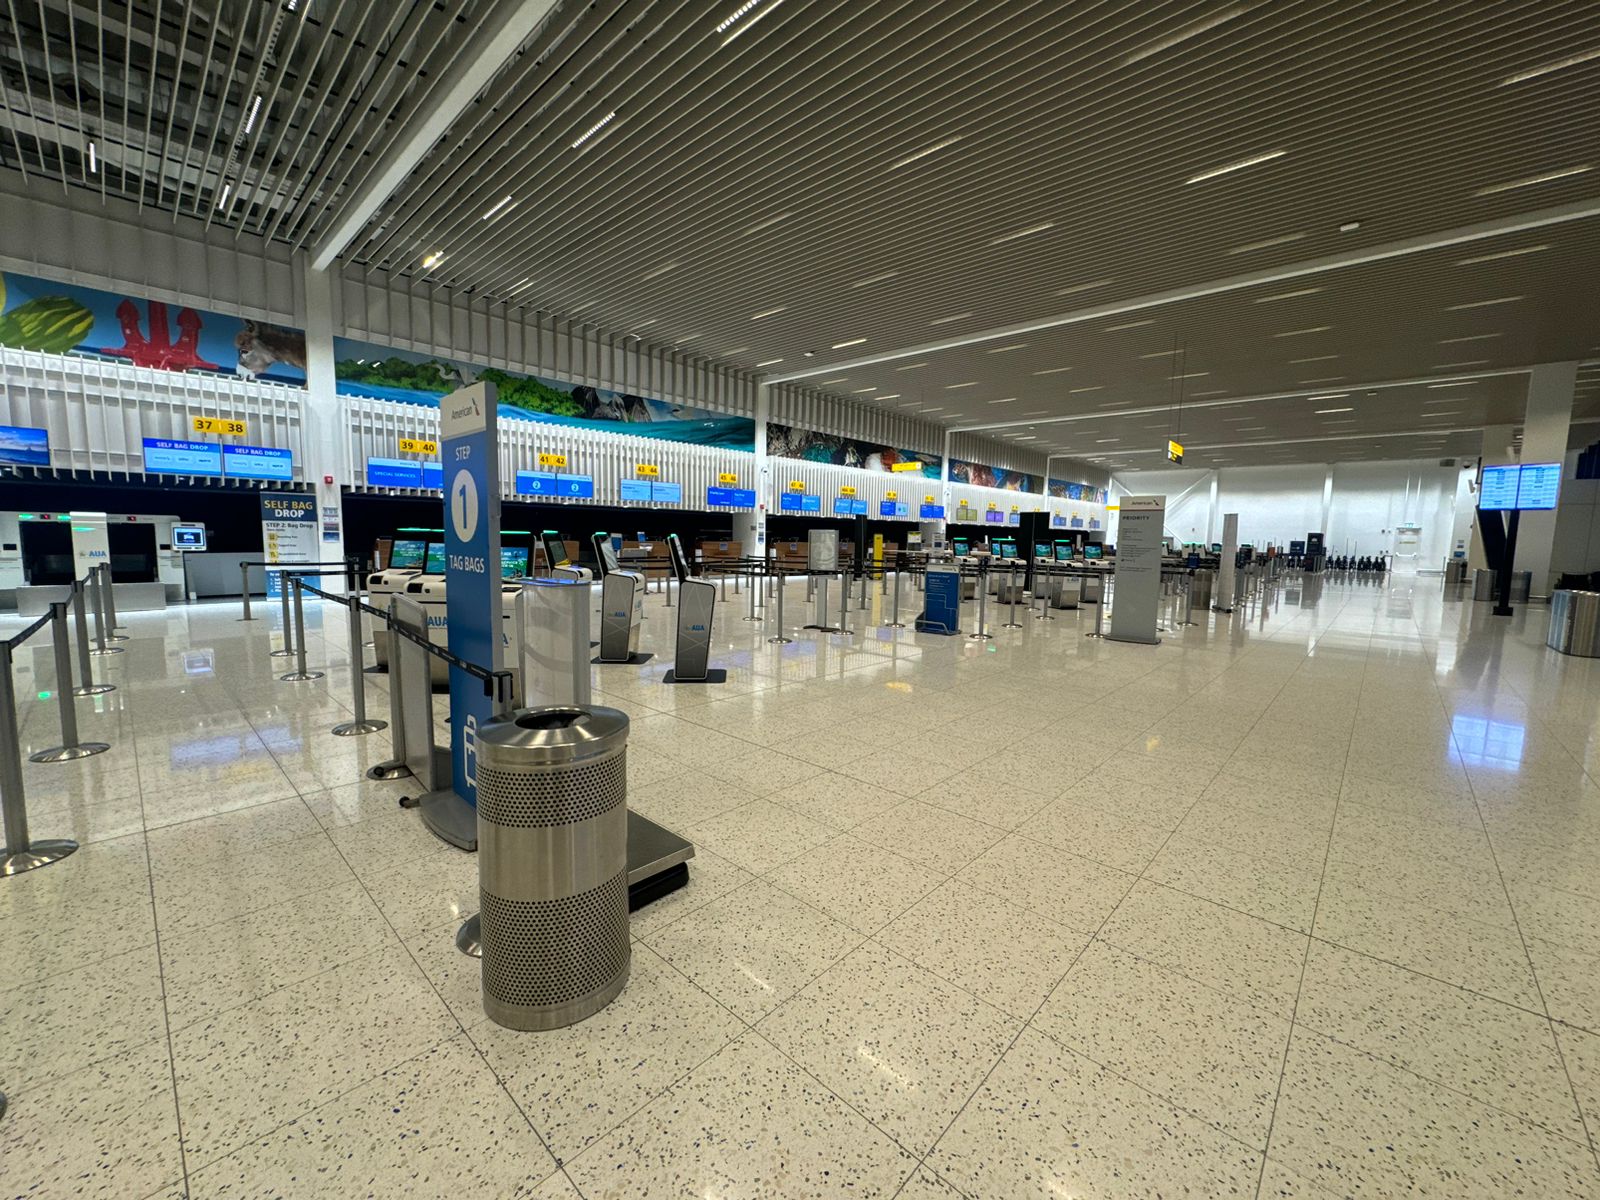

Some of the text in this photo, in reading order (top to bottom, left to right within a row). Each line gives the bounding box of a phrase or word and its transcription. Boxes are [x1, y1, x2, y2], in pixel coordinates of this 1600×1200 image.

[451, 405, 473, 420] American
[196, 419, 243, 433] 37 38
[402, 441, 435, 452] 39 40
[455, 445, 471, 461] STEP
[556, 457, 565, 465] 42
[264, 500, 313, 510] SELF BAG
[459, 484, 467, 530] 1
[274, 509, 305, 518] DROP
[89, 550, 107, 558] AUA
[449, 554, 485, 574] TAG BAGS
